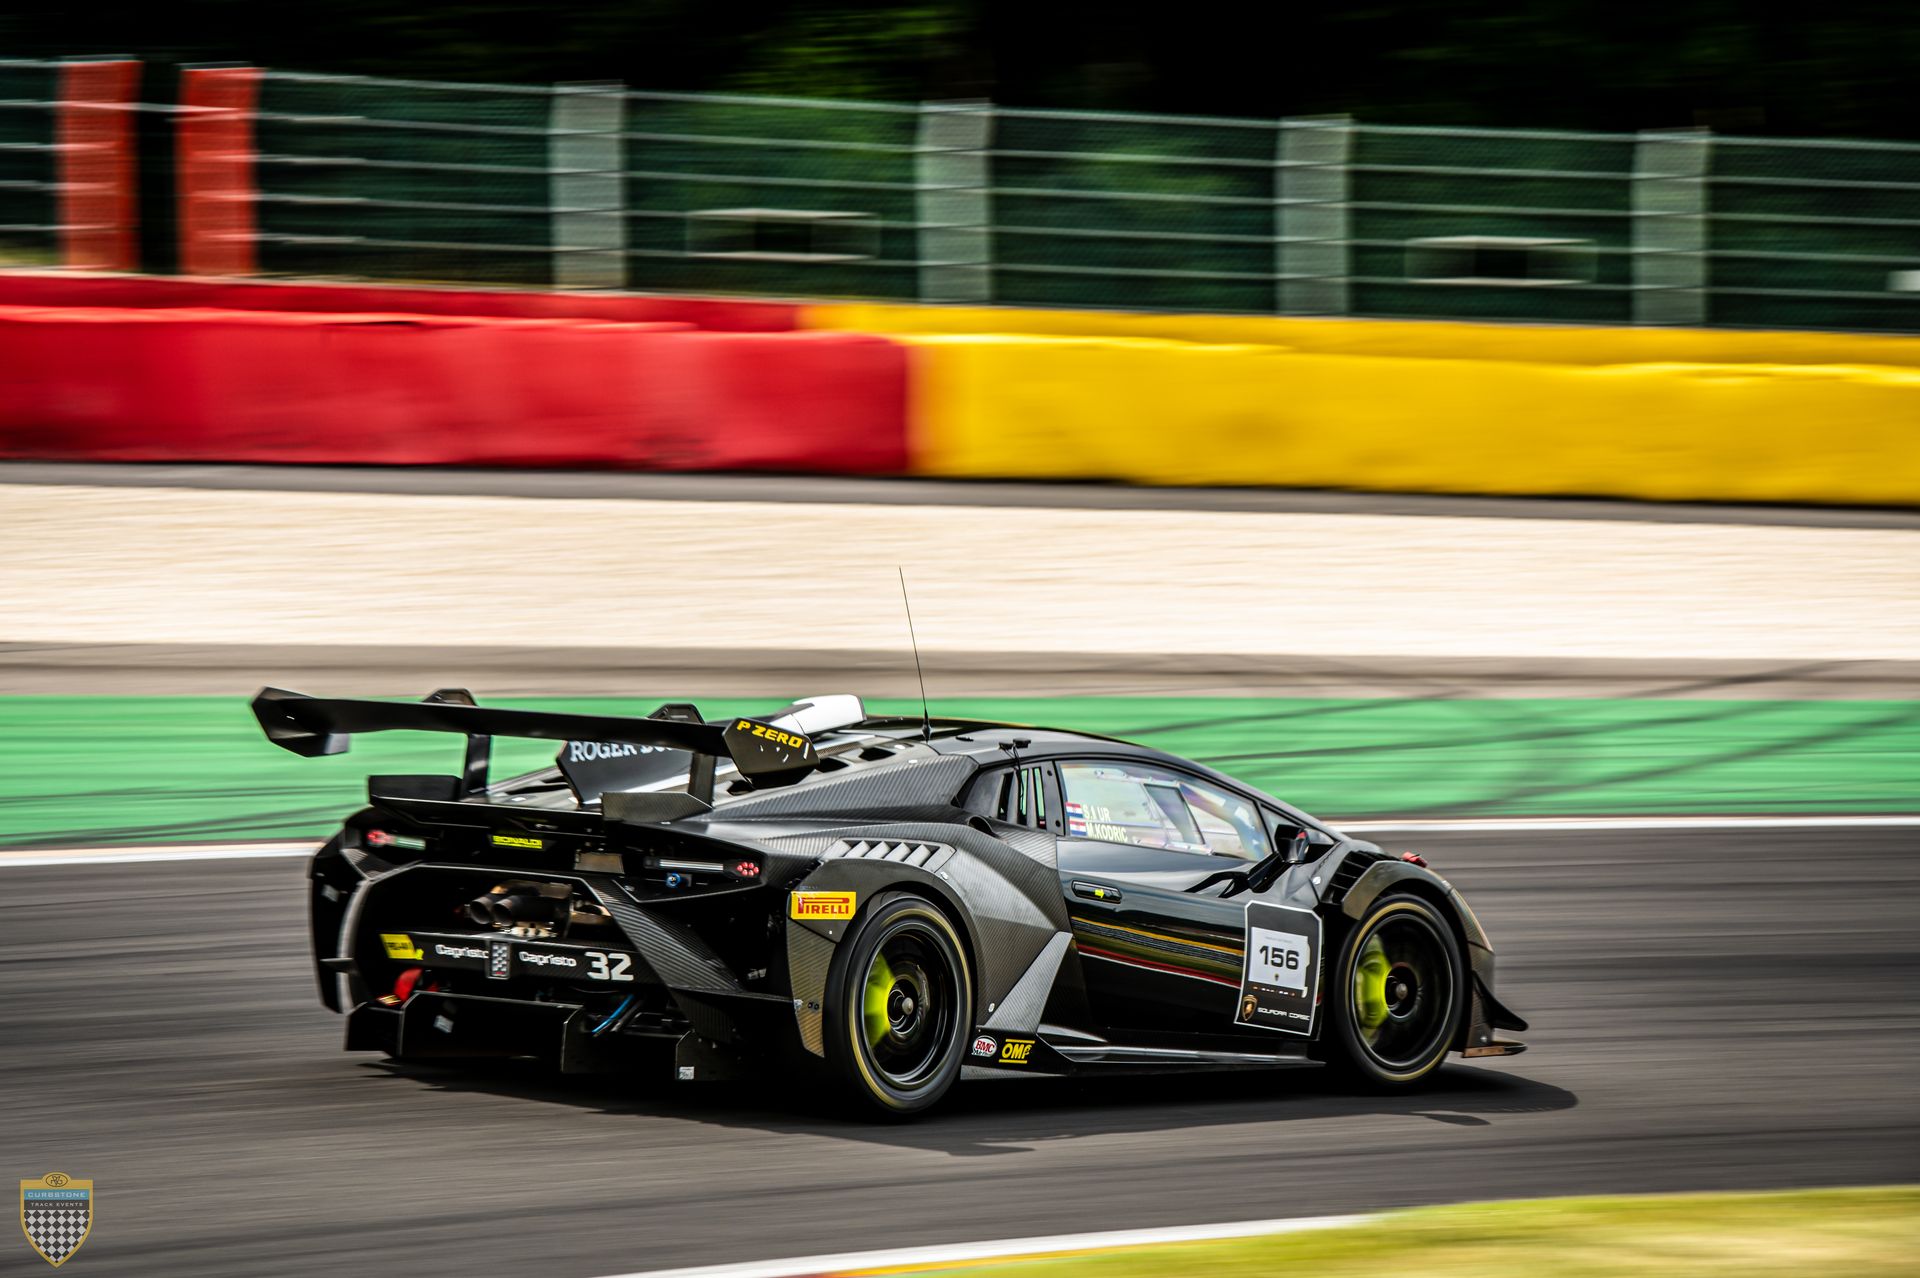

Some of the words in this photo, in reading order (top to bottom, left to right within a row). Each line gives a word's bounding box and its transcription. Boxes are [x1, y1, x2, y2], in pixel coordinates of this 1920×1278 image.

[736, 720, 752, 731] P
[751, 724, 804, 749] ZERO
[569, 740, 638, 763] ROGER
[797, 897, 850, 915] PIRELLI
[519, 951, 577, 967] Capristo
[583, 951, 635, 982] 32
[1259, 945, 1299, 970] 156
[975, 1039, 995, 1054] BMC
